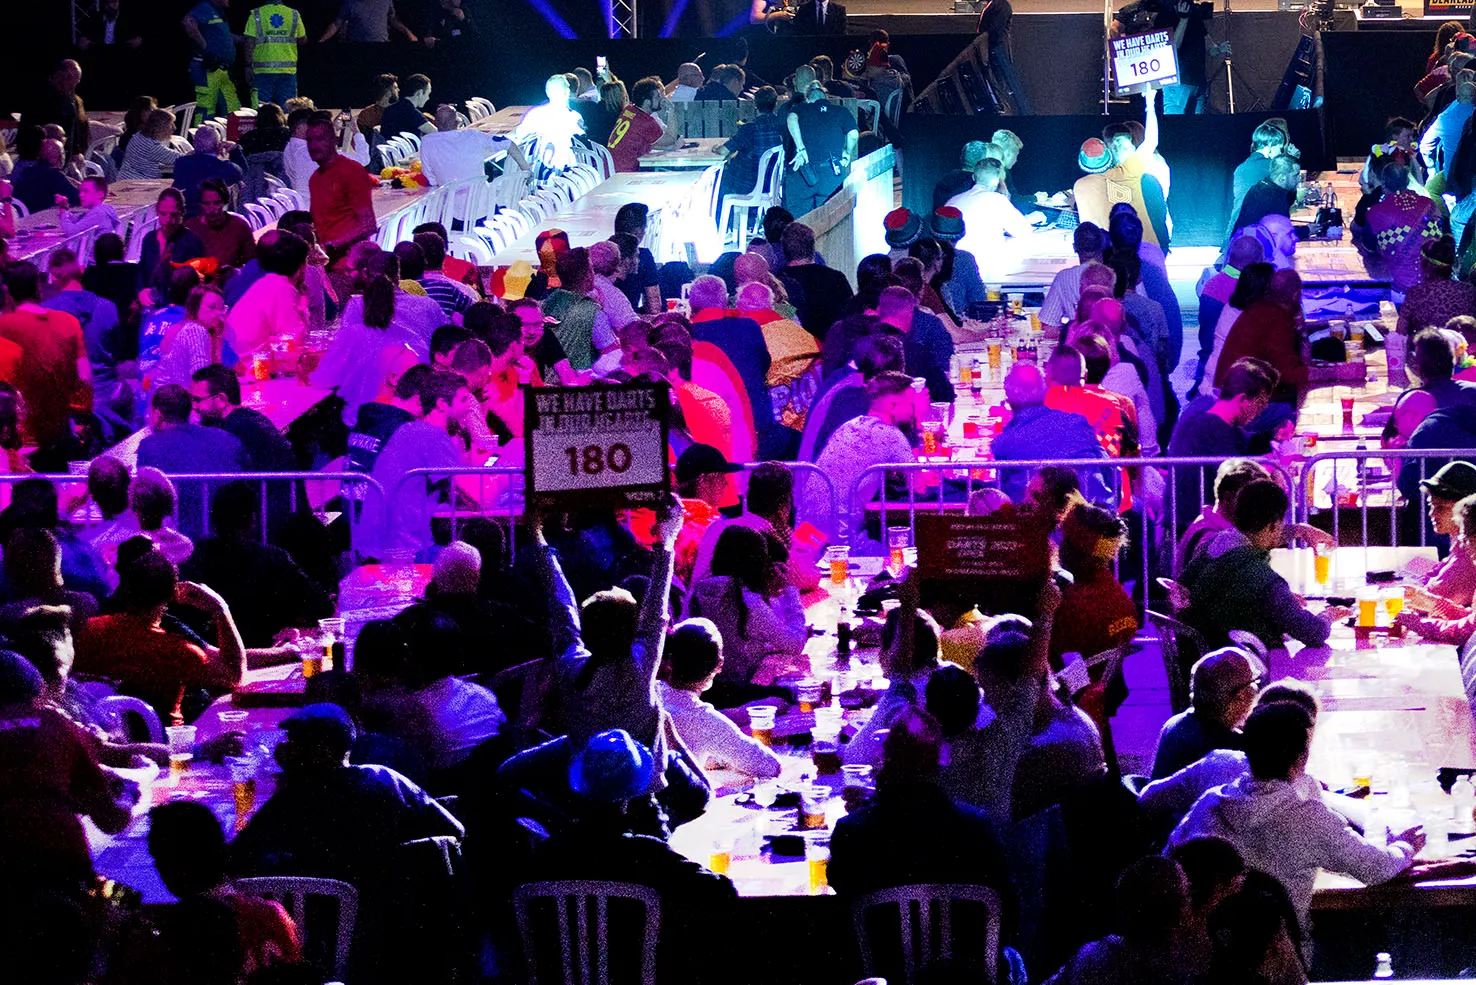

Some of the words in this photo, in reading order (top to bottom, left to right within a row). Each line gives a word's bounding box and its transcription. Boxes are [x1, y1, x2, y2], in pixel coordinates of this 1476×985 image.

[1113, 40, 1126, 51] WE
[1126, 36, 1145, 48] HAVE
[1145, 31, 1169, 45] DARTS
[1130, 59, 1160, 77] 180
[535, 393, 560, 414] WE
[563, 391, 603, 413] HAVE
[605, 388, 656, 411] DARTS
[564, 443, 632, 477] 180
